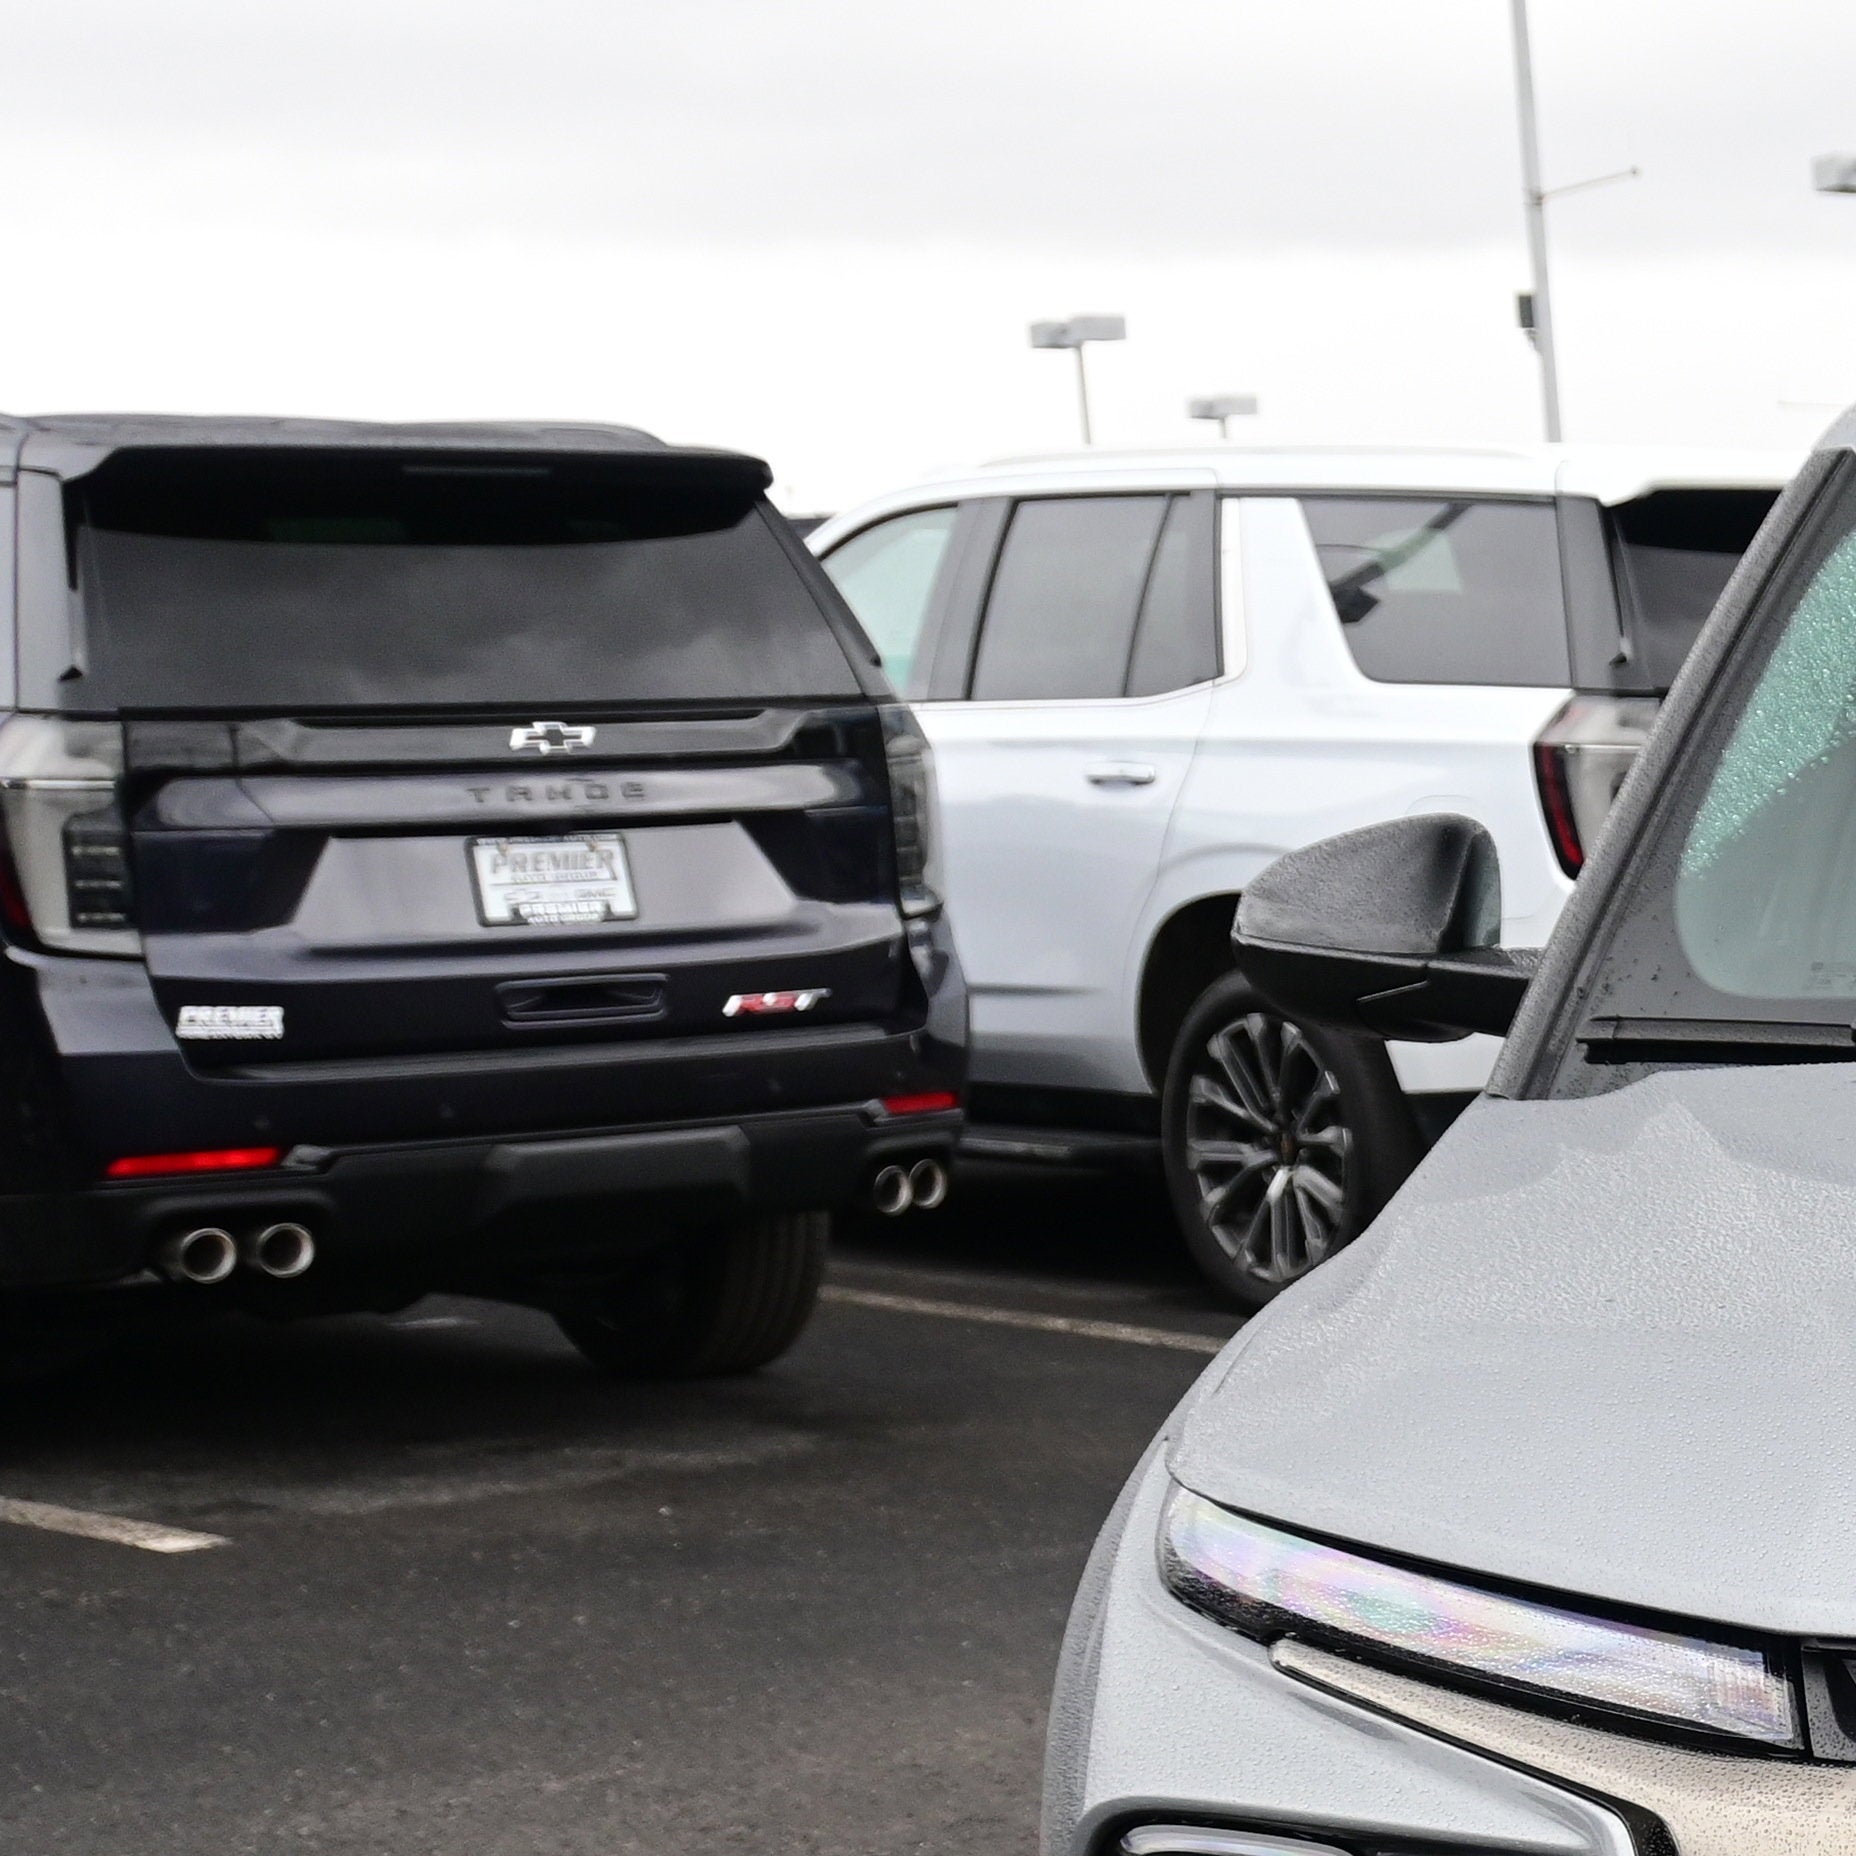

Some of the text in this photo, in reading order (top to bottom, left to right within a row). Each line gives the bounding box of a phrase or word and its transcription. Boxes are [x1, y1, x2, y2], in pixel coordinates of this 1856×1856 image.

[465, 781, 646, 804] TAHOE
[490, 848, 618, 881] PREMIER
[722, 987, 832, 1017] RST
